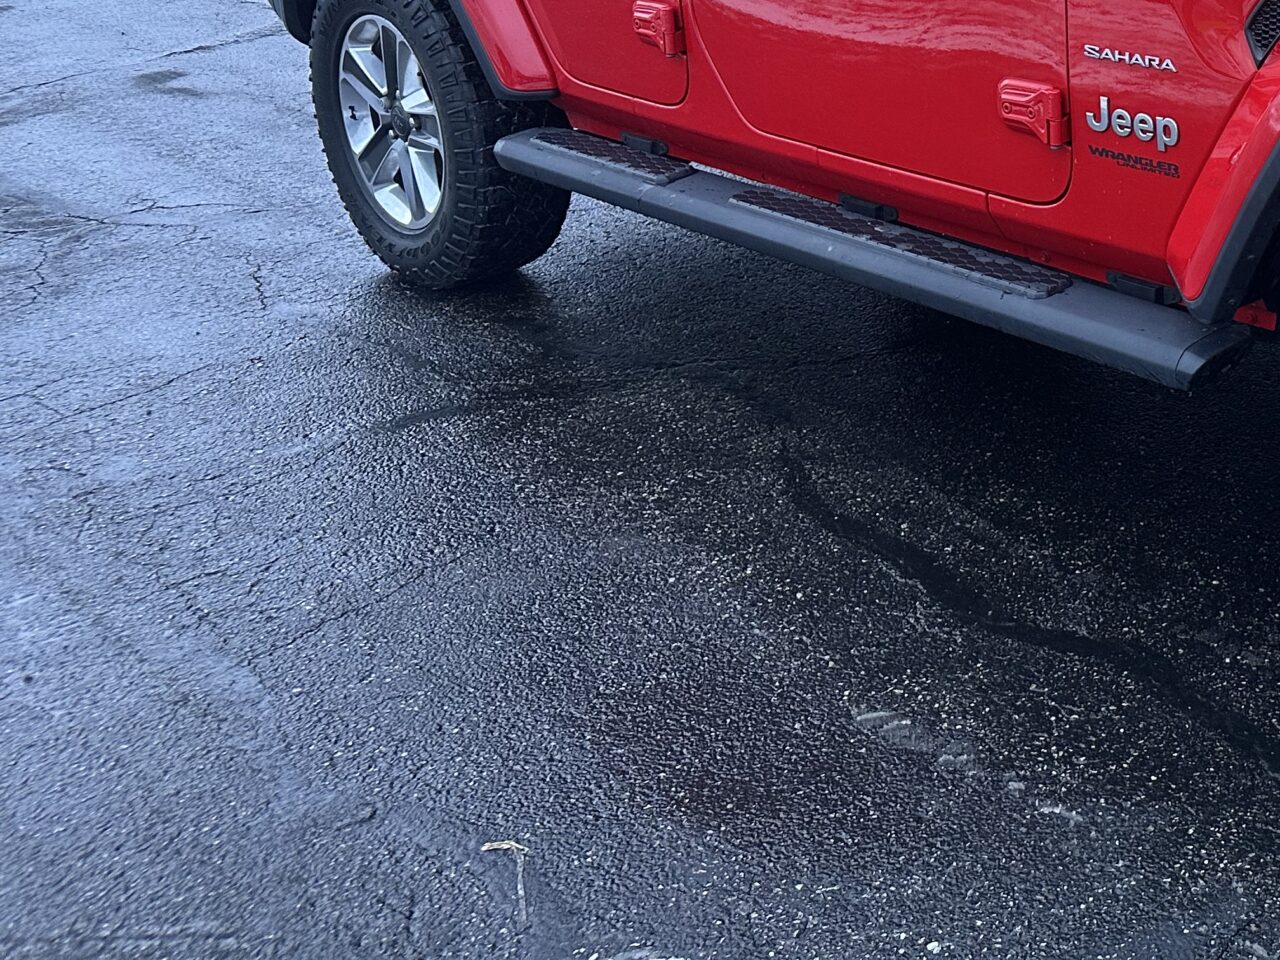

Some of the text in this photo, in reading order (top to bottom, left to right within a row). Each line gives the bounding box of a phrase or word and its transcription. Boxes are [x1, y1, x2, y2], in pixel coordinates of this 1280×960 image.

[1083, 44, 1178, 73] SAHARA
[1085, 95, 1179, 152] Jeep
[1088, 144, 1179, 174] WRANGLER
[1116, 160, 1181, 179] UNLIMITED
